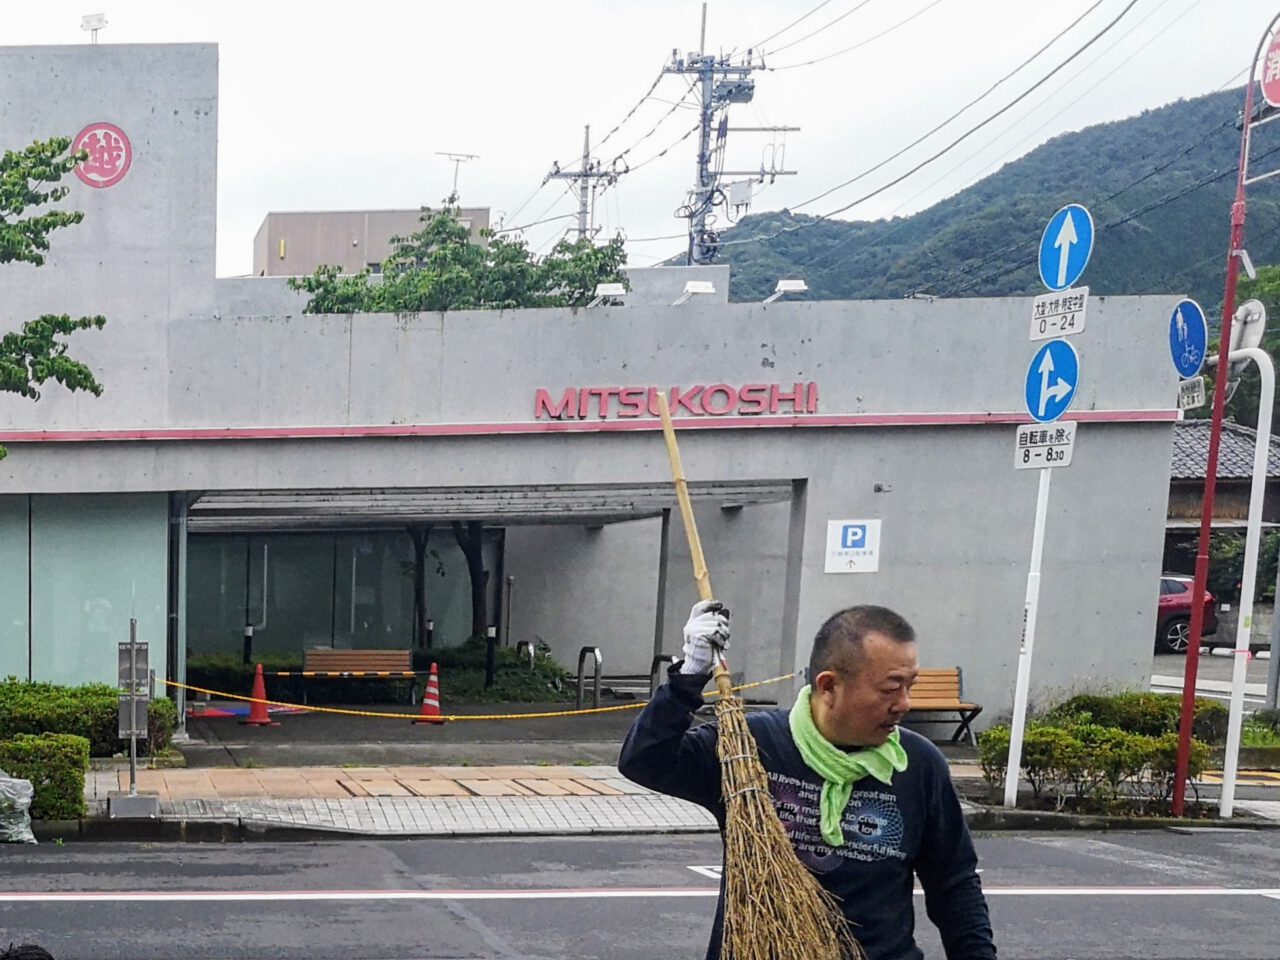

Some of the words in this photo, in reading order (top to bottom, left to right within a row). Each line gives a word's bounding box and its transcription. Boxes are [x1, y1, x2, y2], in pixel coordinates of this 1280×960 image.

[533, 382, 819, 418] MITSUKOSHI
[1019, 427, 1072, 446] 自転車を除く
[846, 527, 863, 546] P
[880, 792, 897, 802] aim
[780, 810, 795, 821] life
[796, 814, 818, 826] that
[783, 802, 801, 813] my
[845, 813, 857, 821] to
[795, 830, 811, 841] life
[798, 842, 816, 852] are
[817, 846, 835, 856] my
[835, 849, 874, 862] wishes
